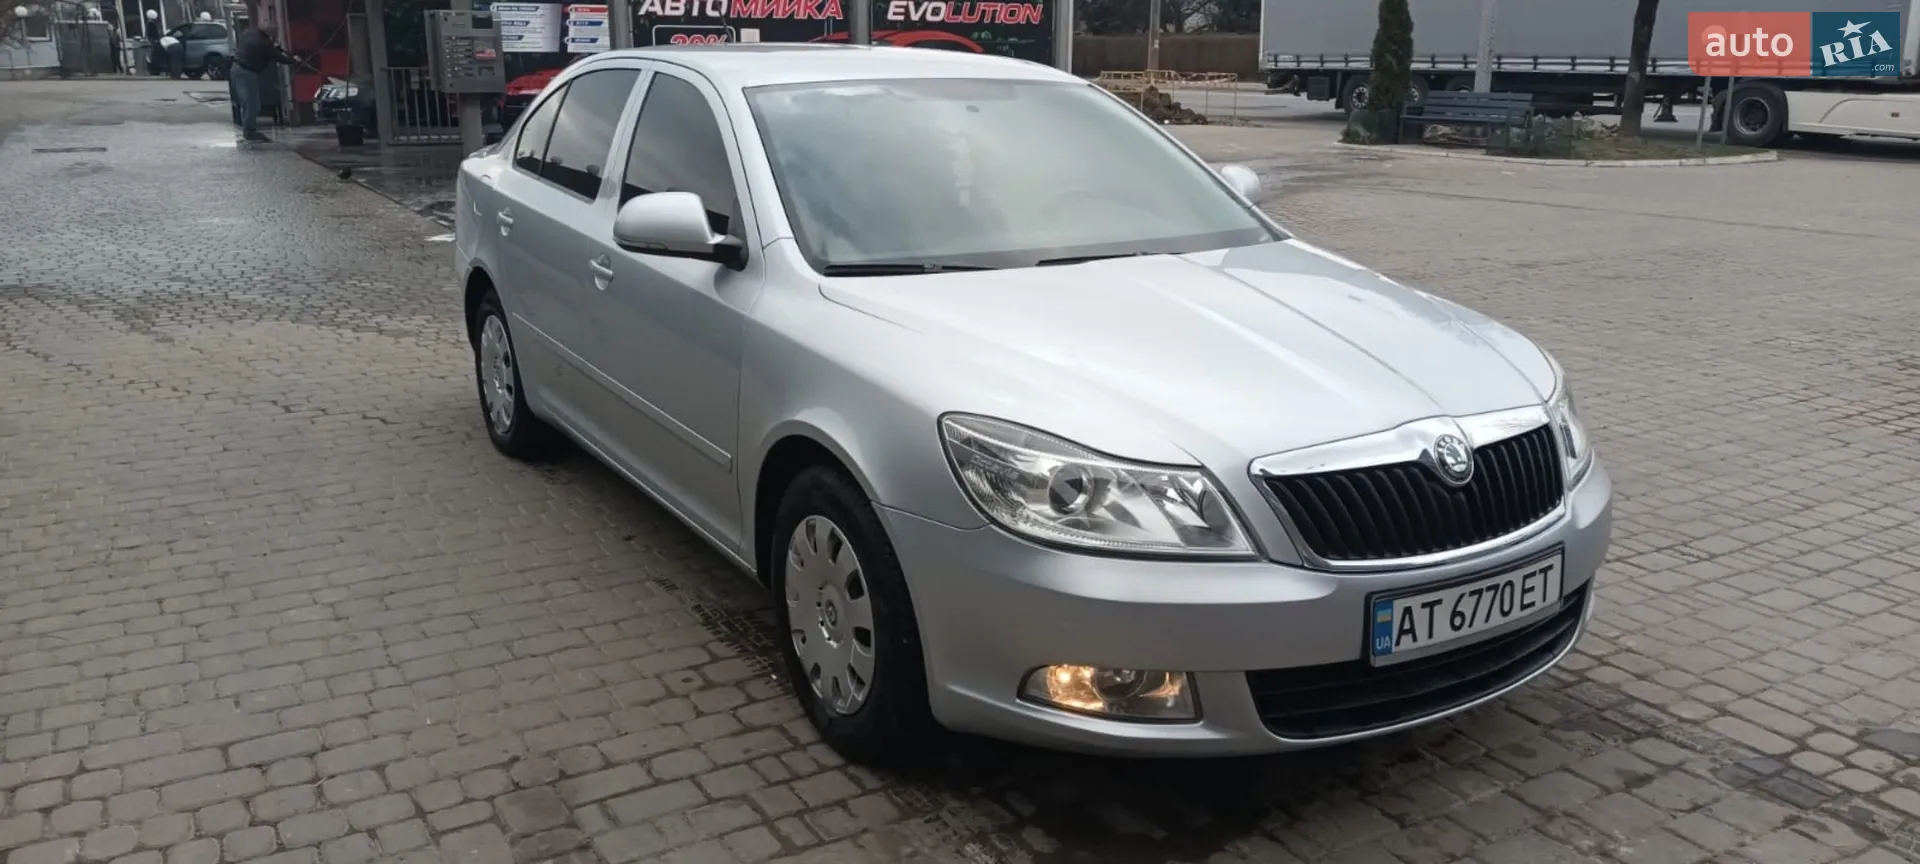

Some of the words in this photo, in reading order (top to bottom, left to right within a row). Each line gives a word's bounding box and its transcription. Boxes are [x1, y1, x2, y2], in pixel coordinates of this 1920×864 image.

[887, 1, 1043, 24] EVOLUTION
[1395, 598, 1443, 647] AT
[1449, 580, 1514, 632] 6770
[1519, 564, 1554, 611] ET
[1376, 636, 1391, 650] UA
